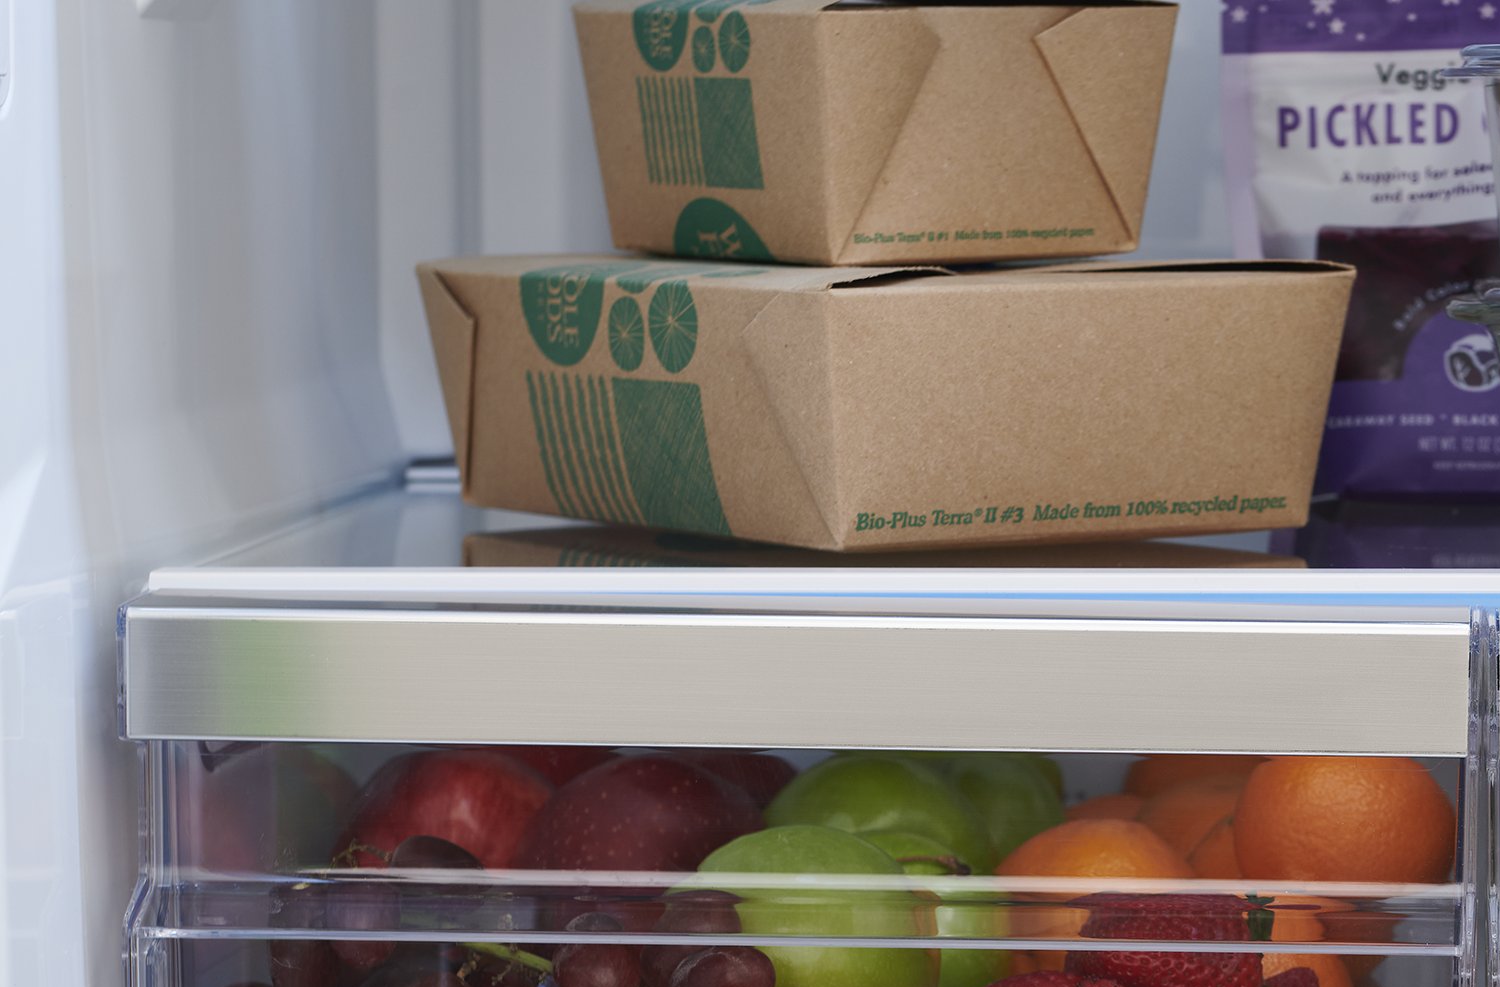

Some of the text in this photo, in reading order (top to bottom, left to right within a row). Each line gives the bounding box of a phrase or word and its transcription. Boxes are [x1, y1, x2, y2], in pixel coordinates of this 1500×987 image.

[1277, 102, 1460, 149] PICKLED
[1356, 170, 1419, 185] topping
[1424, 166, 1448, 181] for
[1371, 190, 1403, 204] and
[855, 511, 927, 532] Bio-Plus
[983, 507, 997, 523] II
[1000, 507, 1024, 523] #3
[1032, 504, 1080, 521] Made
[1083, 502, 1121, 518] from
[1126, 499, 1168, 516] 100%
[1169, 495, 1237, 515] recycled
